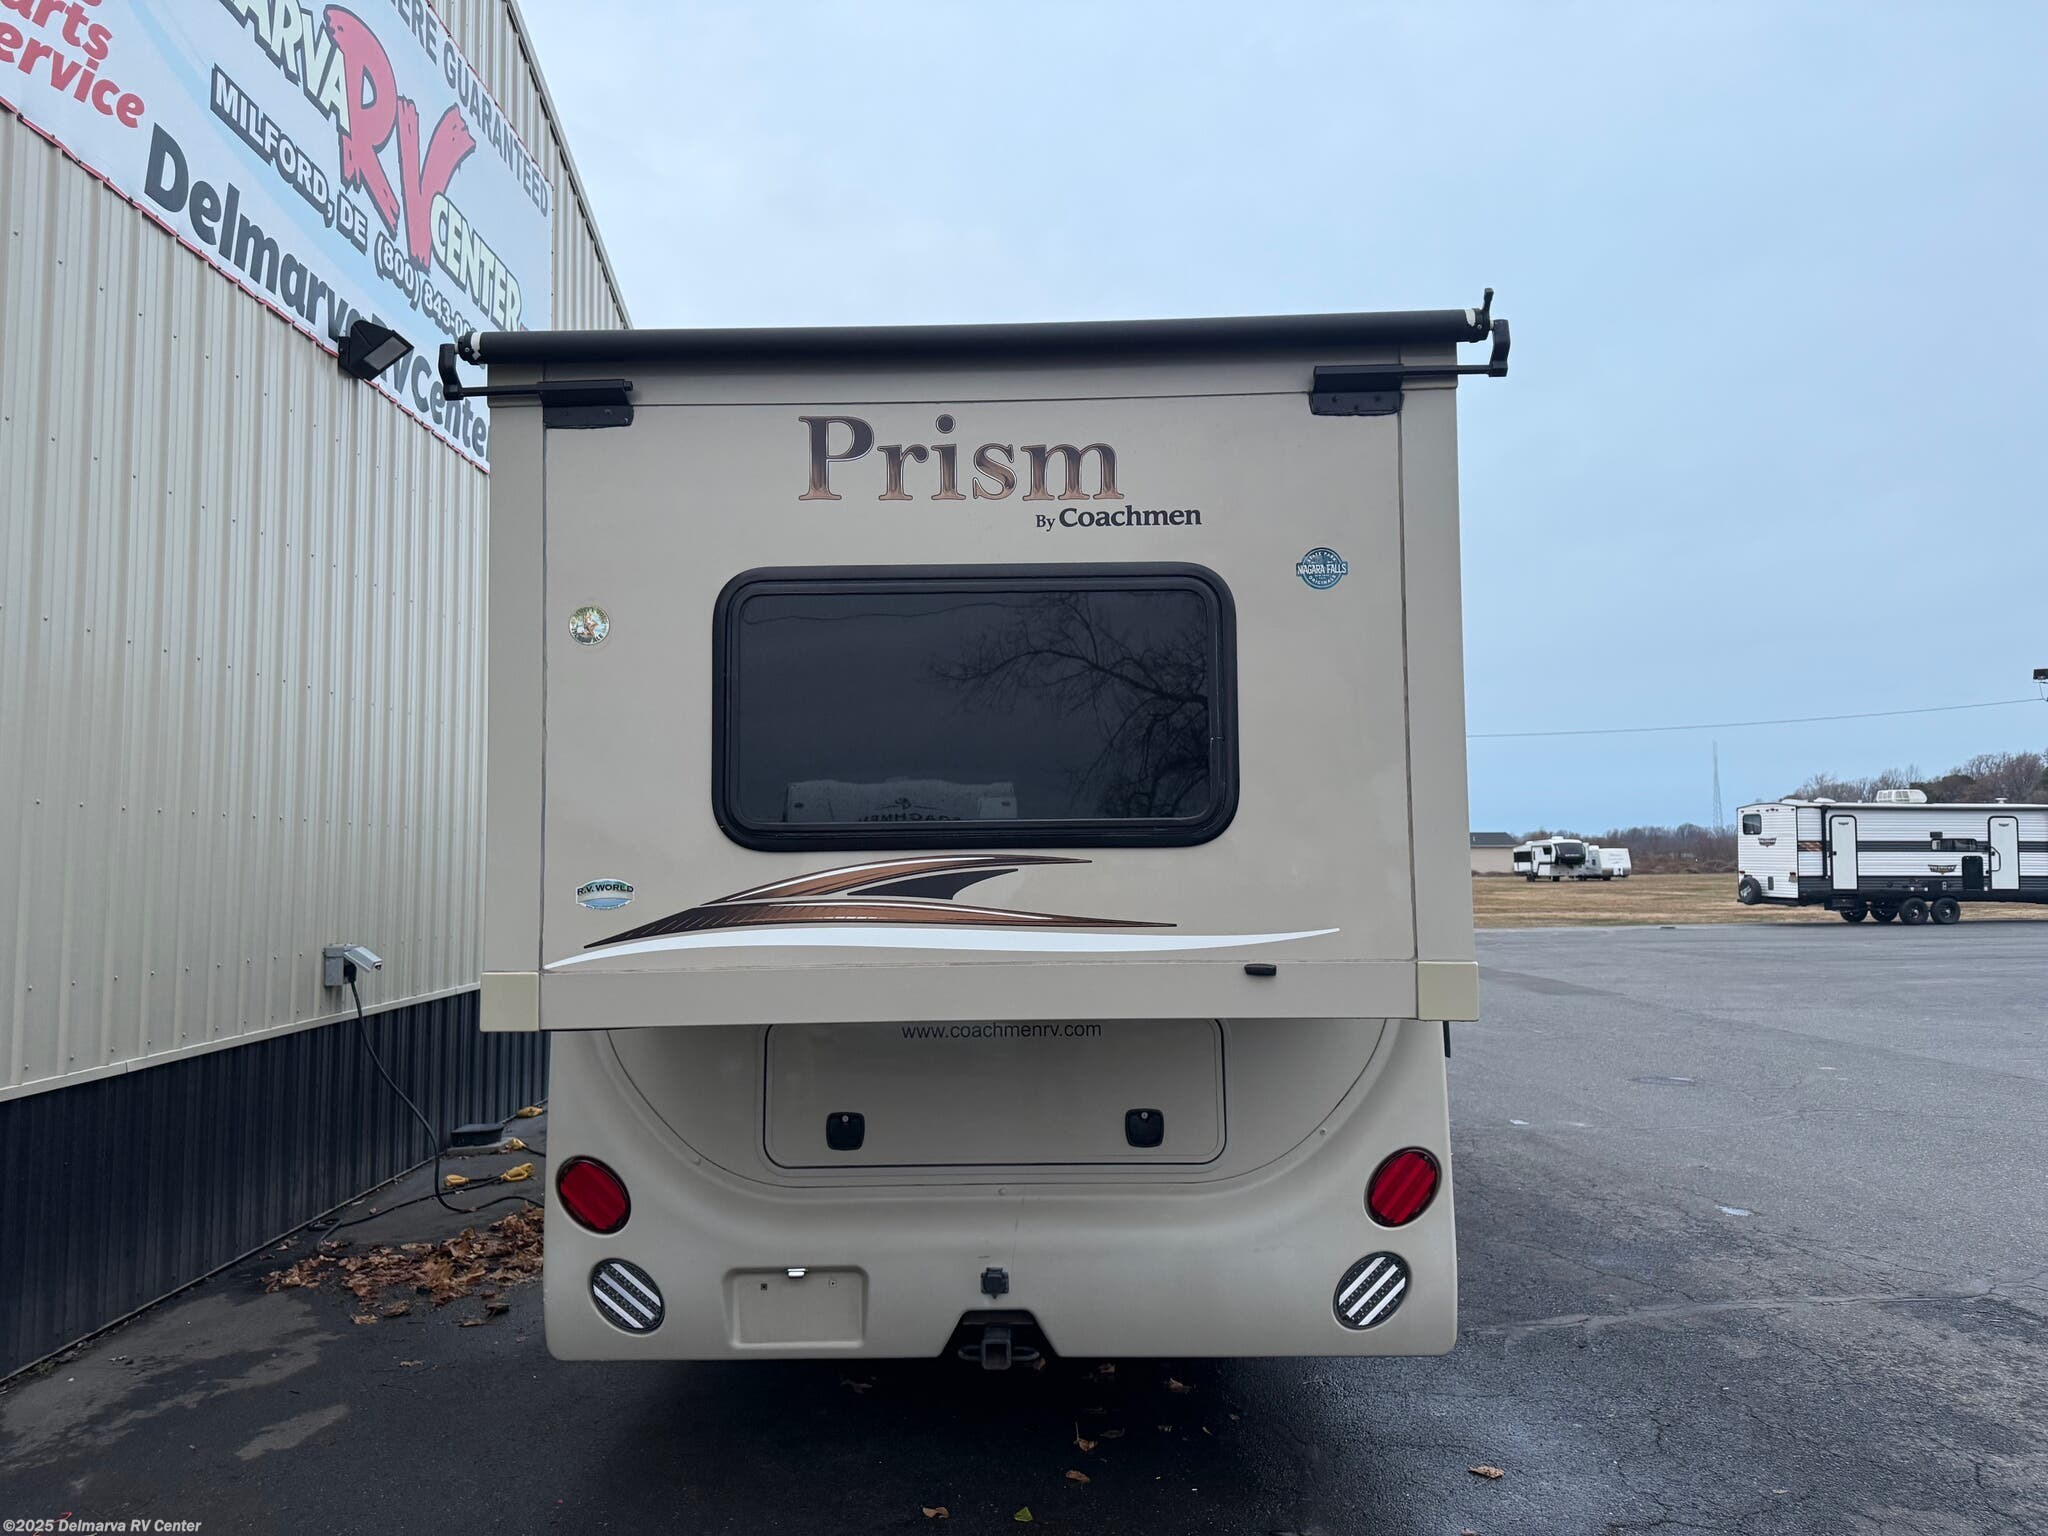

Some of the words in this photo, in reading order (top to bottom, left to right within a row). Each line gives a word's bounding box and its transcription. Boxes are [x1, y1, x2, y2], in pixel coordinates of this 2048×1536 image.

[0, 0, 113, 60] rts
[0, 22, 145, 128] ervice
[391, 0, 437, 65] ERE
[443, 40, 549, 218] GUARANTEED
[219, 0, 350, 136] ARVA
[322, 4, 476, 273] RV
[430, 192, 522, 331] CENTER
[210, 63, 335, 228] MILFORD,
[335, 190, 368, 256] DE
[375, 230, 421, 311] (800)
[421, 279, 478, 343] 843-0
[798, 414, 1125, 501] Prism
[1036, 514, 1056, 530] By
[1059, 505, 1202, 528] Coachmen
[1326, 563, 1347, 574] FALLS
[577, 886, 595, 896] R.V.
[596, 883, 634, 893] WORLD
[902, 1021, 1102, 1039] www.coachmenrv.com
